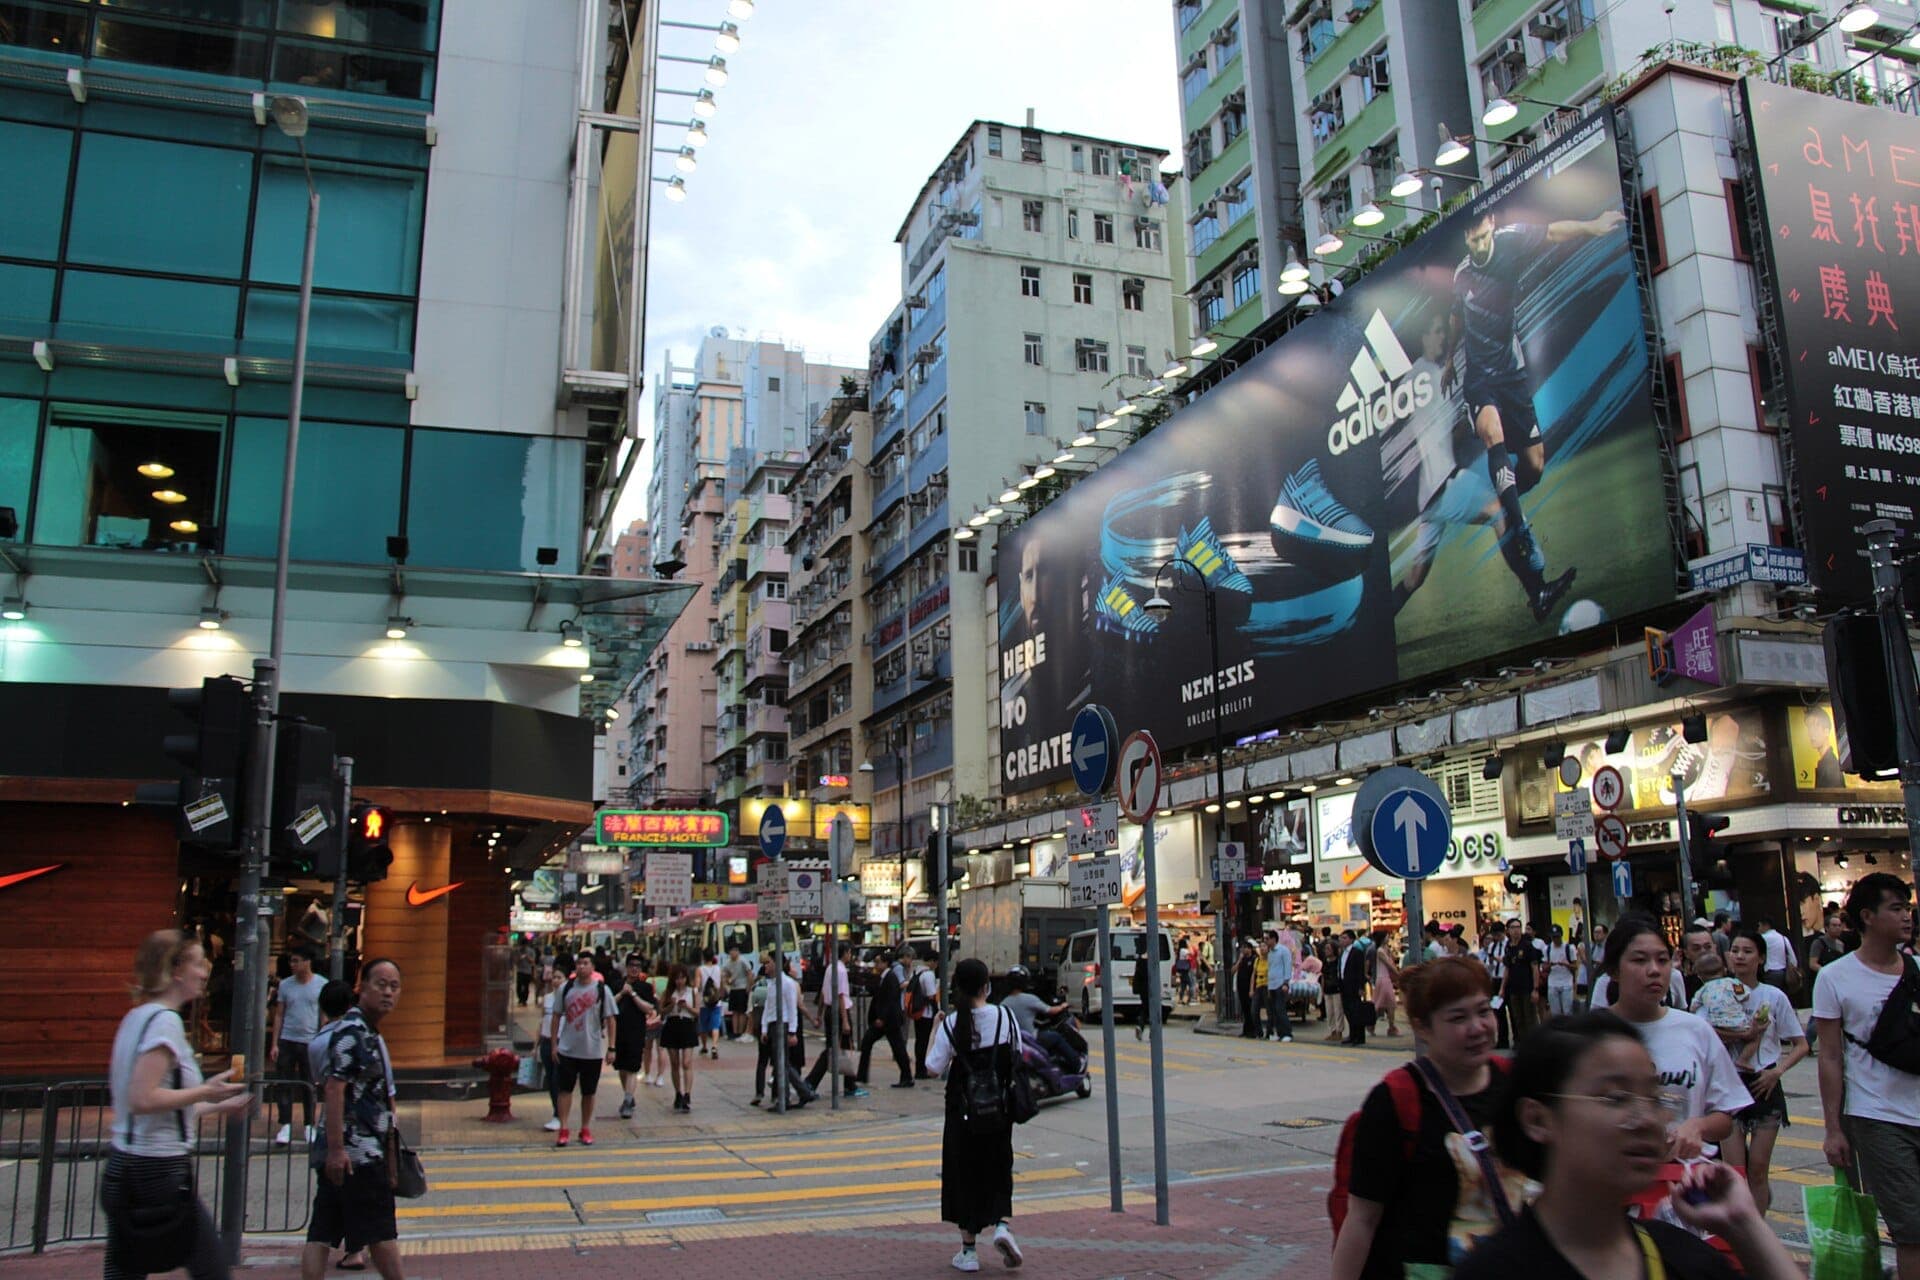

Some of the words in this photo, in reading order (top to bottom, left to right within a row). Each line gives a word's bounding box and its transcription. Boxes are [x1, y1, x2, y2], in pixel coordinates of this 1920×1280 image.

[1327, 371, 1434, 456] adidas
[1003, 631, 1047, 680] HERE
[1692, 626, 1713, 673] 旺電
[1181, 658, 1256, 704] NEMESIS
[1004, 696, 1027, 730] TO
[1220, 695, 1253, 717] AGILITY
[1005, 731, 1072, 782] CREATE
[612, 832, 668, 843] FRANCIS
[670, 831, 710, 843] HOTEL
[1104, 829, 1116, 845] 10
[1107, 882, 1118, 897] 10
[1262, 869, 1302, 892] adidas
[1431, 910, 1467, 919] crocs
